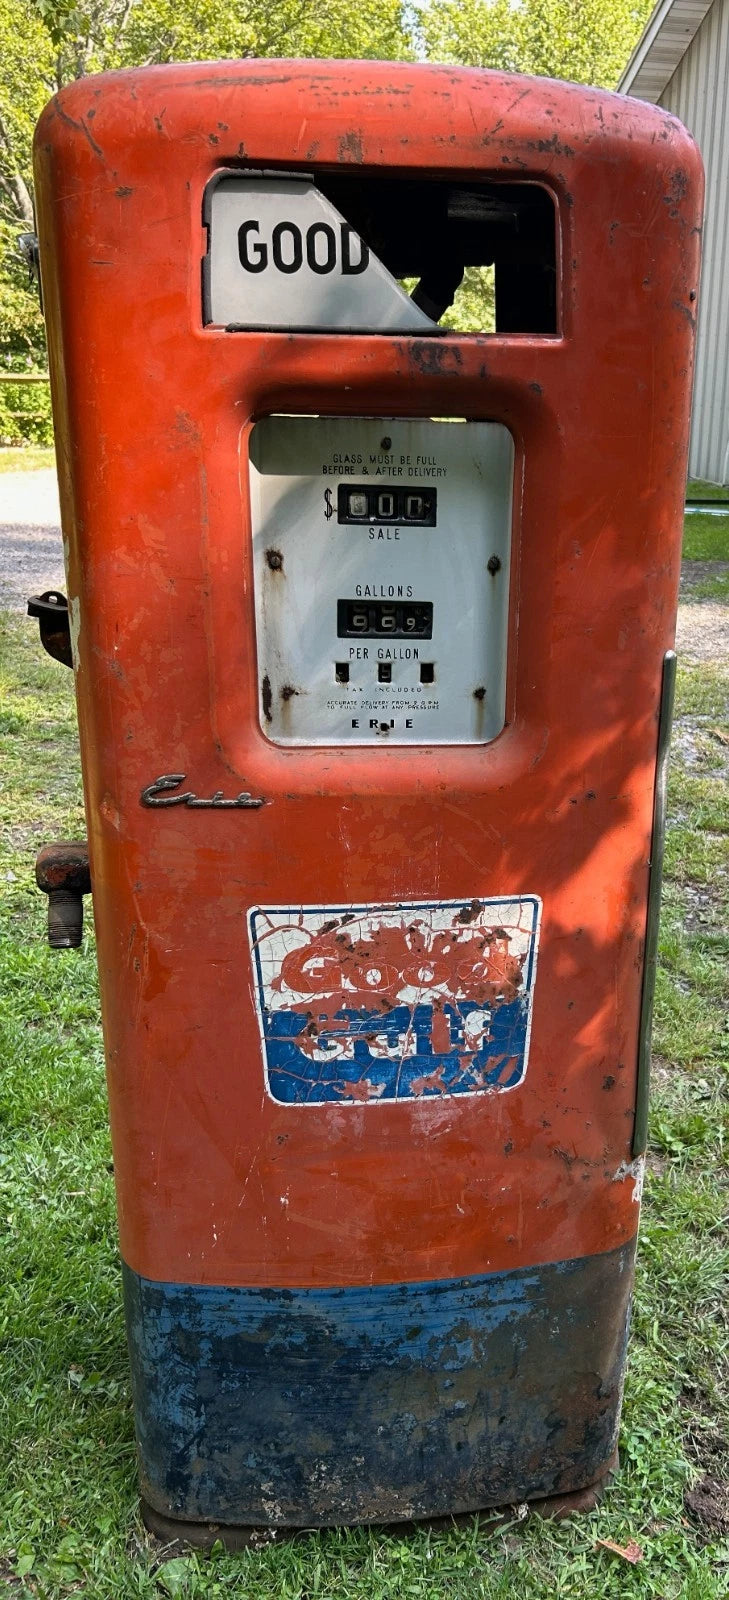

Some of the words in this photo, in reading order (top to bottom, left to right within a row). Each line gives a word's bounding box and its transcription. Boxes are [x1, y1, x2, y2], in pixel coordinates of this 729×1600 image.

[238, 220, 370, 276] GOOD
[333, 454, 362, 463] GLASS
[370, 455, 394, 464] MUST
[401, 456, 411, 464] BE
[417, 456, 437, 465] FULL
[323, 466, 355, 474] BEFORE
[362, 466, 369, 474] &
[376, 467, 403, 476] AFTER
[409, 467, 447, 477] DELIVERY
[324, 488, 332, 520] $
[369, 528, 400, 540] SALE
[356, 585, 413, 597] GALLONS
[350, 648, 369, 659] PER
[378, 648, 419, 659] GALLON
[352, 719, 413, 728] ERIE
[142, 774, 264, 808] Erie
